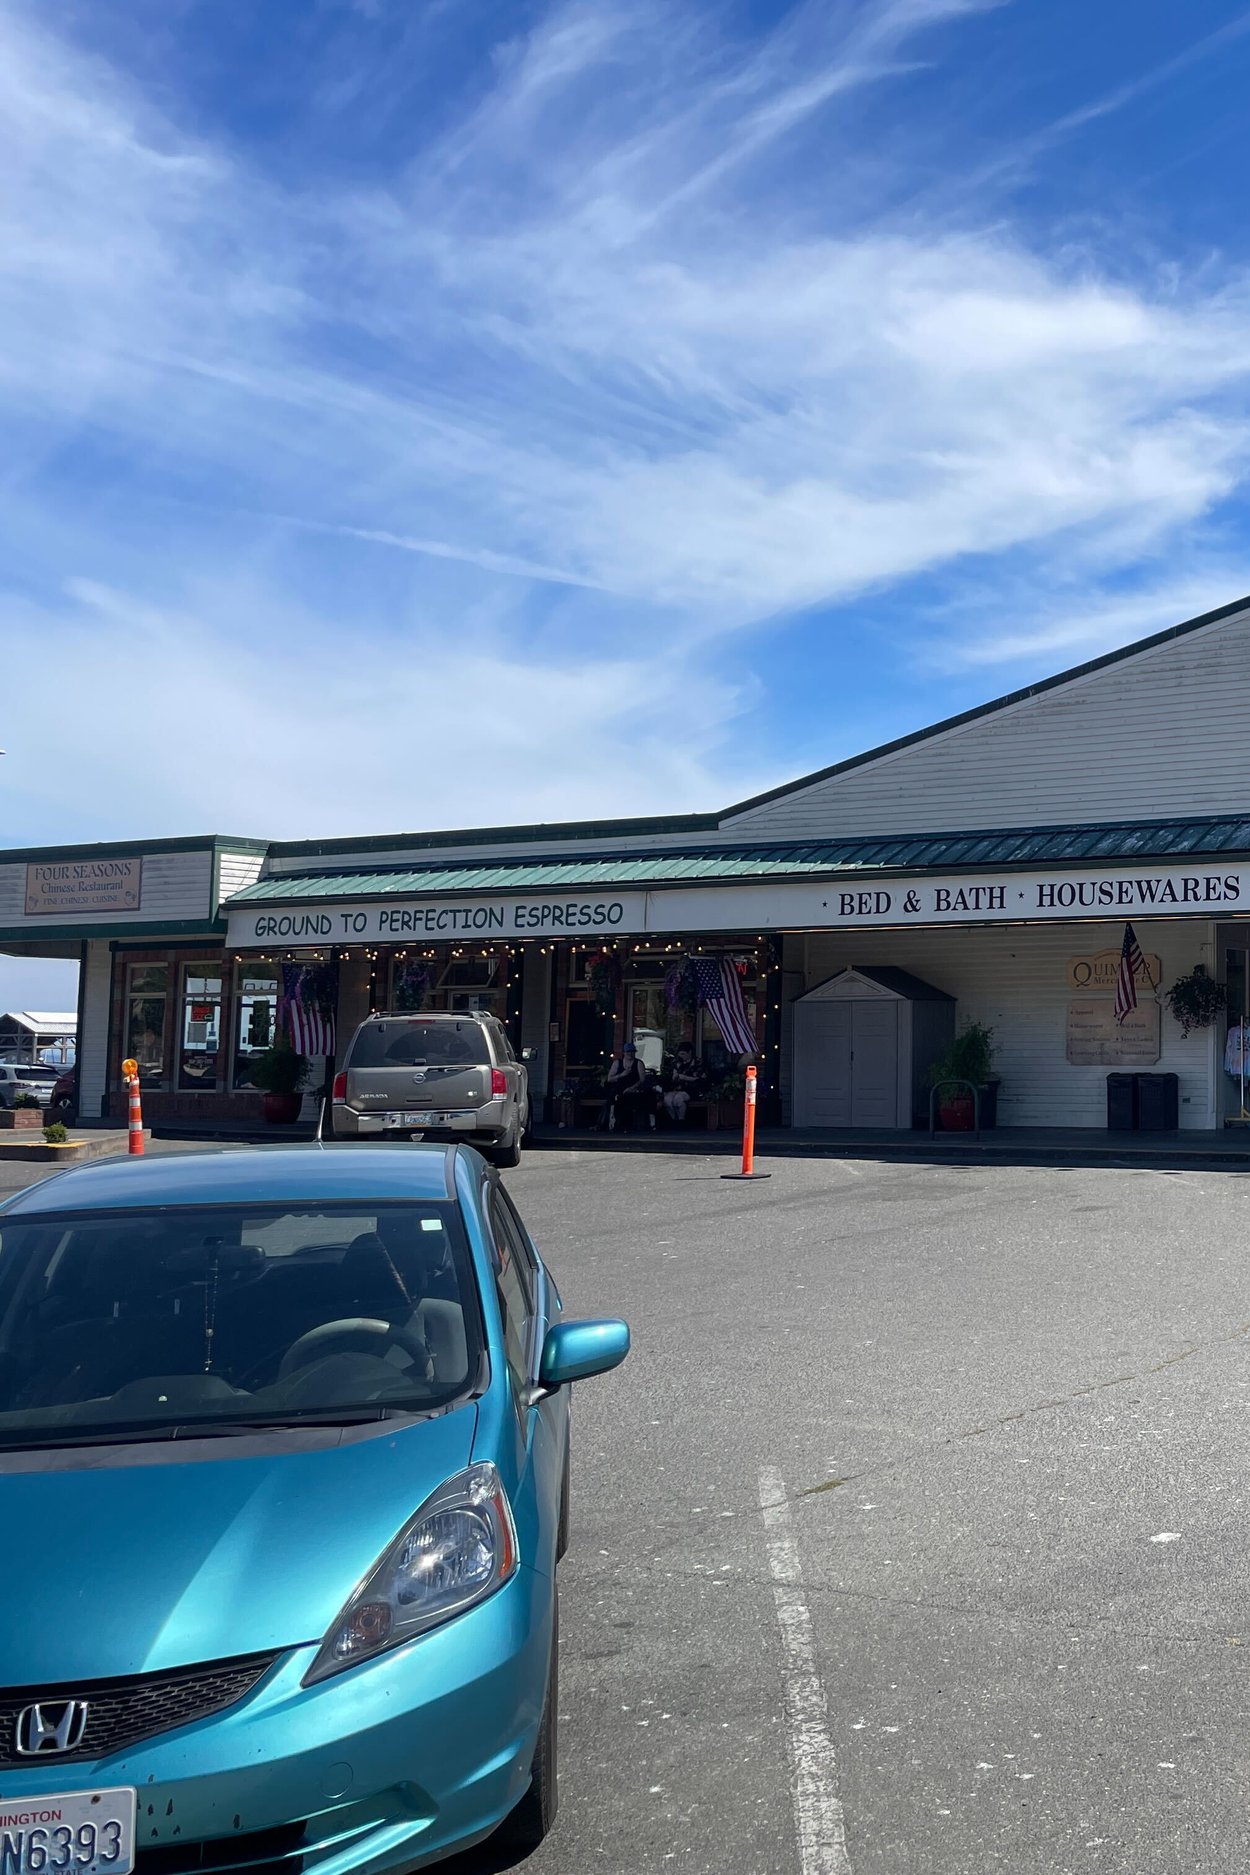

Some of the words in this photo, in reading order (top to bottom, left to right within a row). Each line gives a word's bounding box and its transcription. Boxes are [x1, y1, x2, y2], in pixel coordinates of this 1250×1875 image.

[35, 866, 69, 881] FOUR
[72, 862, 132, 879] SEASONS
[41, 882, 75, 894] Chinese
[78, 879, 123, 892] Restaurant
[838, 891, 892, 916] BED
[903, 889, 921, 913] &
[934, 885, 1007, 912] BATH
[1036, 874, 1241, 907] HOUSEWARES
[255, 914, 332, 937] GROUND
[340, 912, 367, 933] TO
[378, 907, 504, 932] PERFECTION
[514, 902, 624, 928] ESPRESSO
